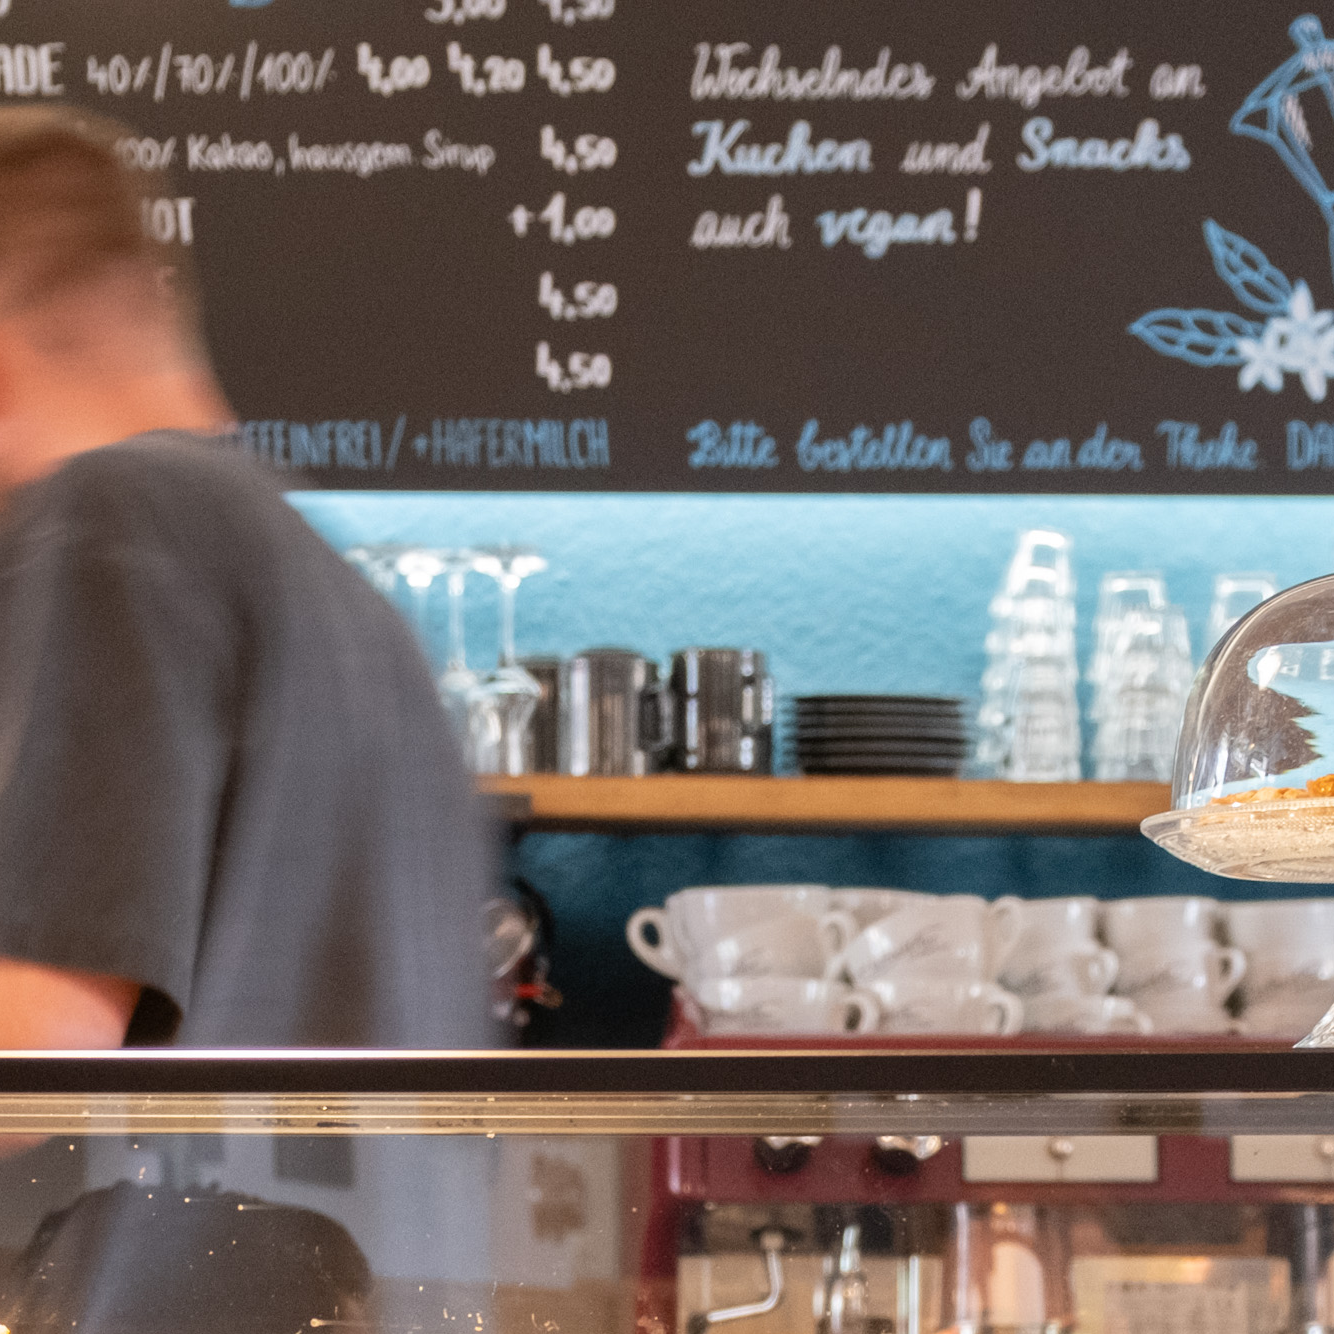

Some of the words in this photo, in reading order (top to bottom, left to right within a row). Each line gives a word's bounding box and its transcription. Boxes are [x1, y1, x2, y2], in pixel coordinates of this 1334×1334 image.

[690, 41, 936, 101] Wechselndes
[956, 42, 1134, 110] Angebot
[1149, 61, 1206, 100] an
[687, 118, 873, 177] Kuchen
[899, 120, 993, 175] und
[1017, 116, 1192, 173] Snacks
[689, 193, 794, 249] auch
[685, 418, 781, 470] Bitte
[795, 417, 955, 473] bestellen
[965, 414, 1015, 473] Sie
[1154, 418, 1259, 472] Theke
